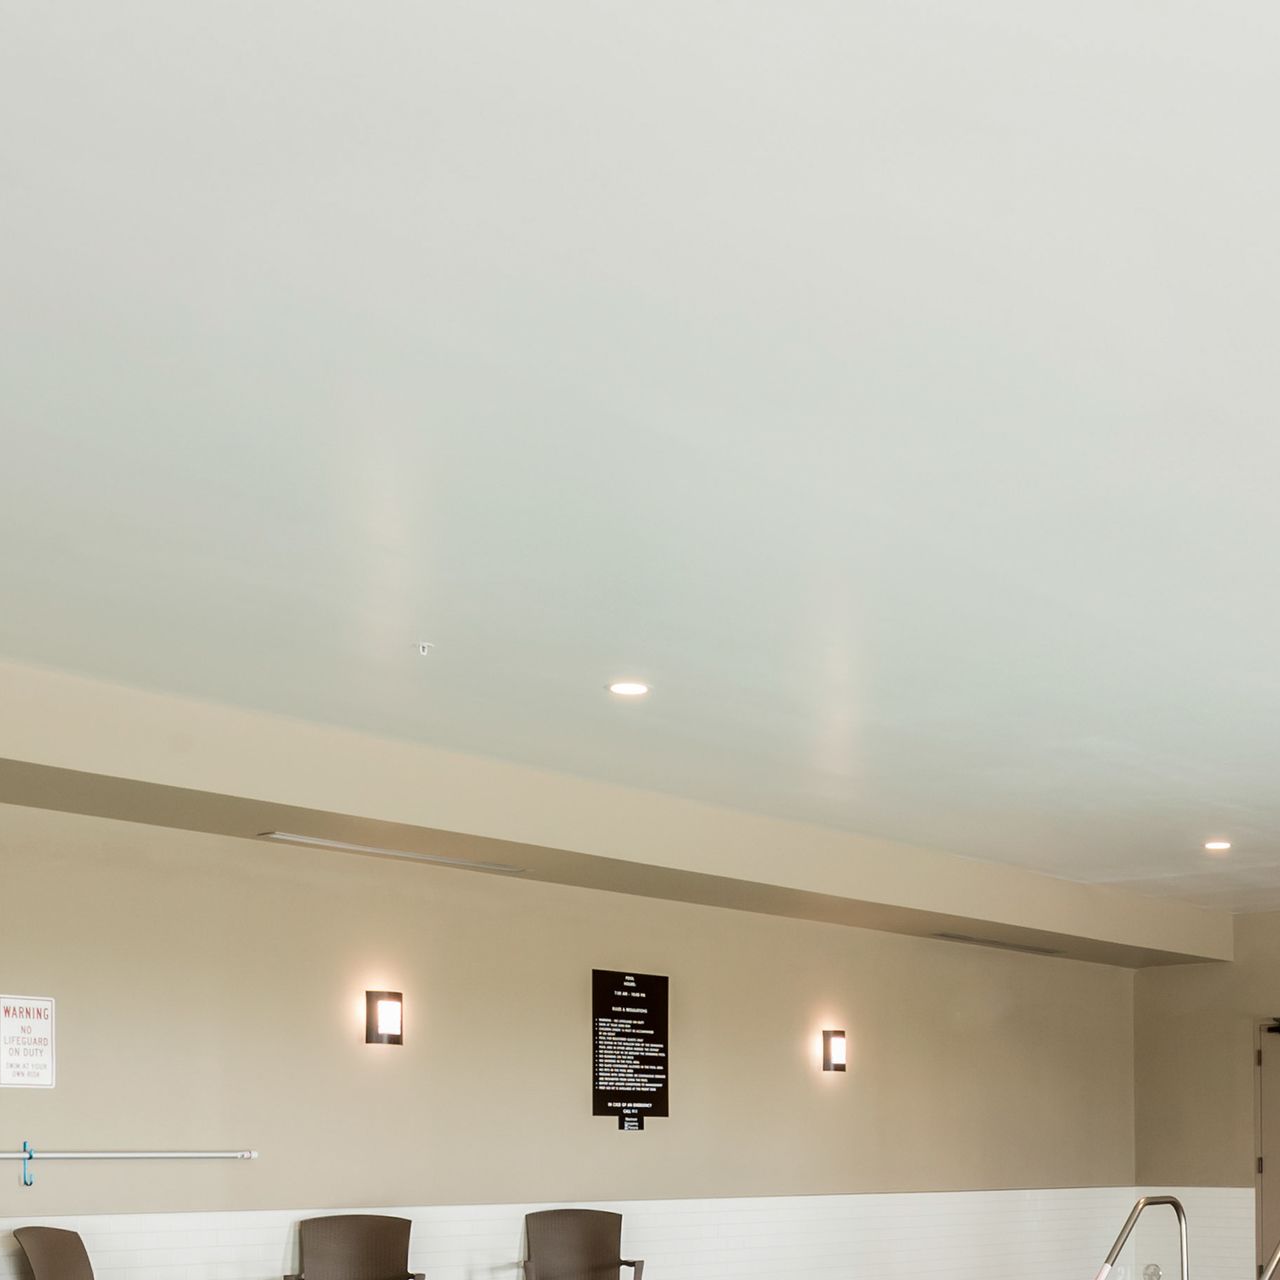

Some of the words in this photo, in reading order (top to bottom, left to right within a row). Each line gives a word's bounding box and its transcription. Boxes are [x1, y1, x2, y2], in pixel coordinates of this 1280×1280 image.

[3, 1006, 49, 1020] WARNING
[20, 1025, 32, 1035] NO
[3, 1036, 49, 1046] LIFEGUARD
[8, 1047, 20, 1056] ON
[23, 1048, 44, 1057] DUTY
